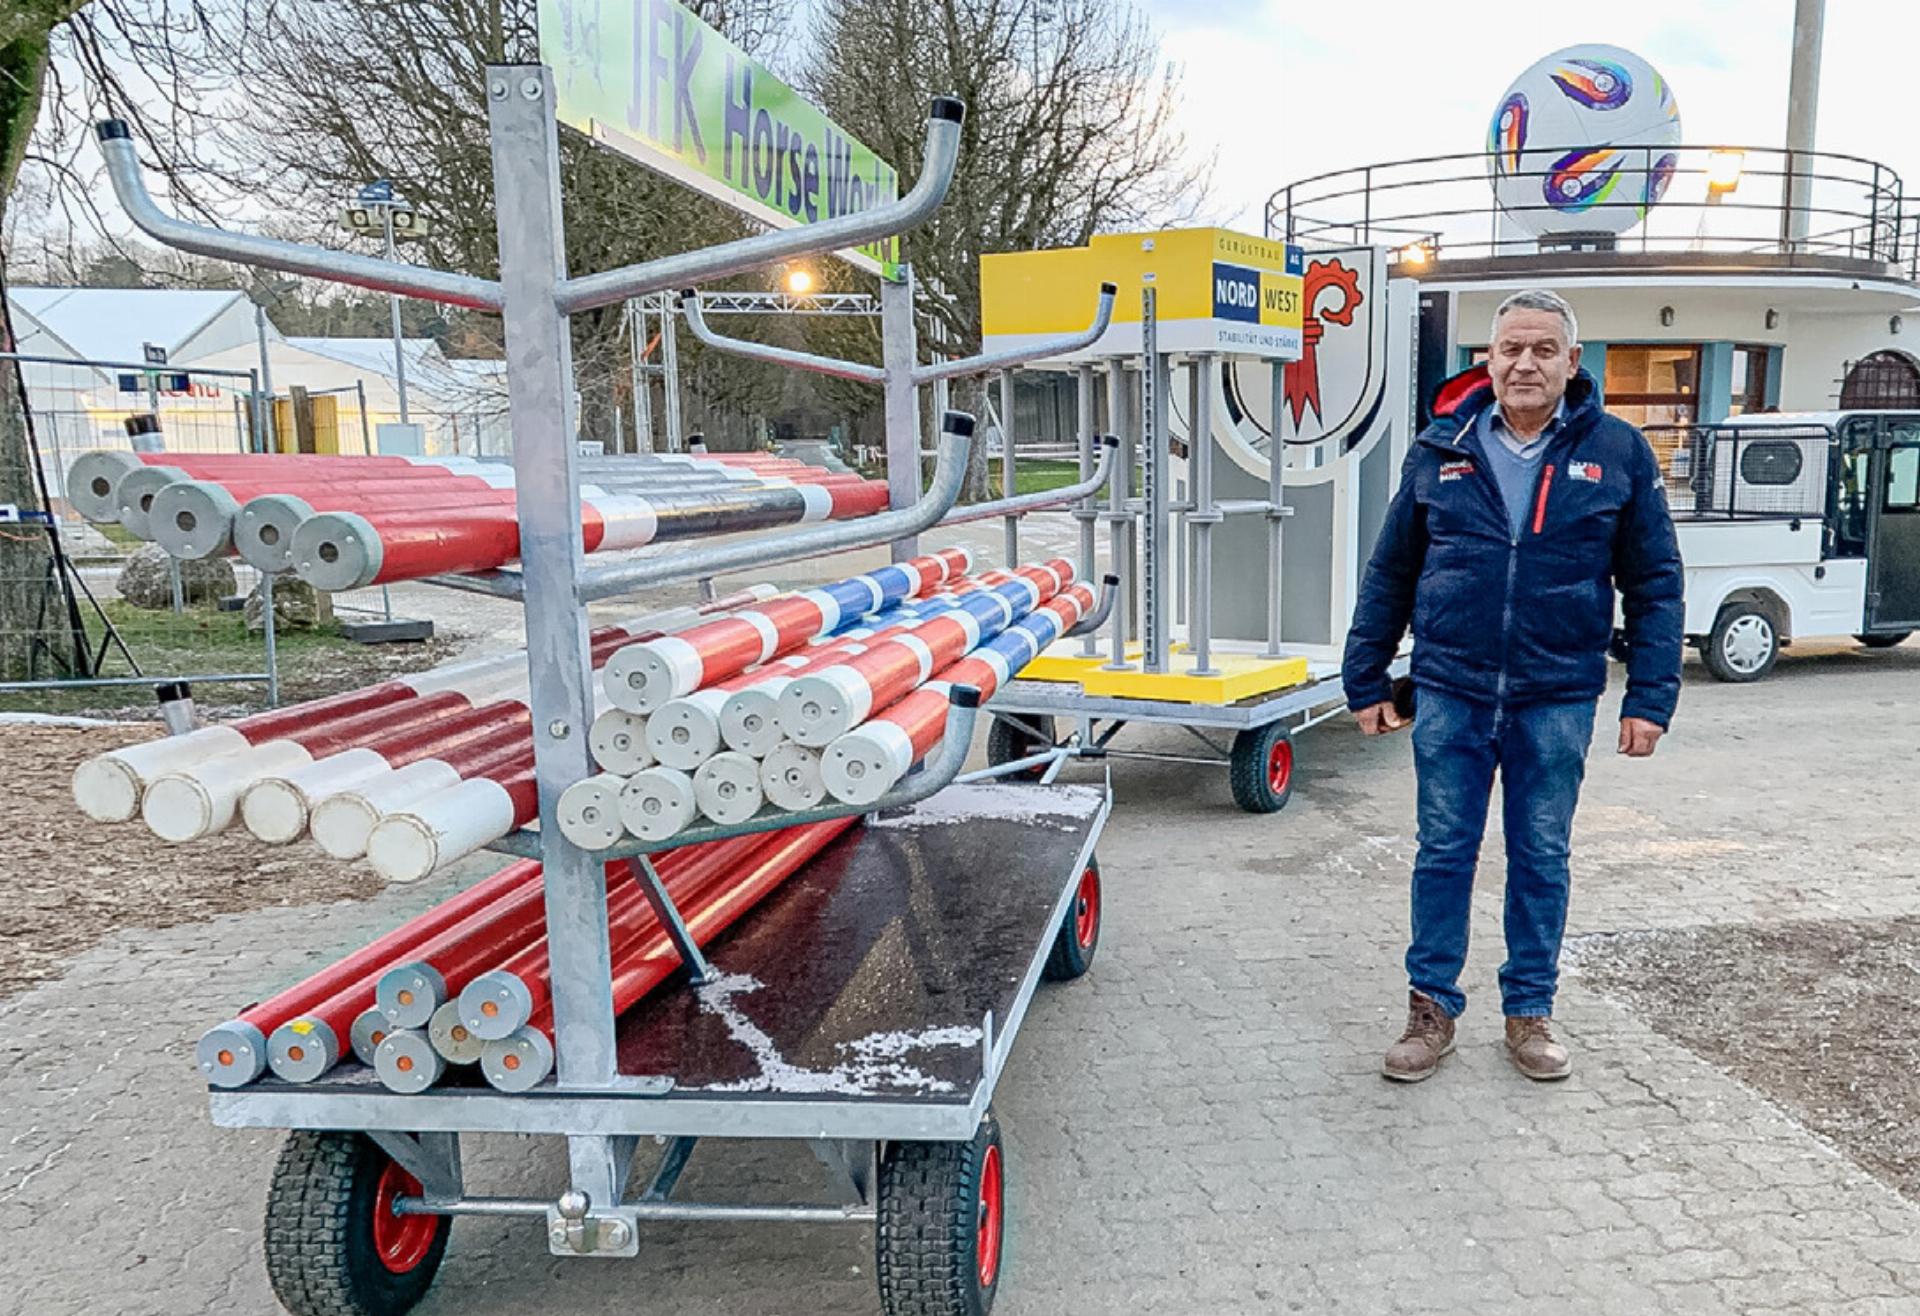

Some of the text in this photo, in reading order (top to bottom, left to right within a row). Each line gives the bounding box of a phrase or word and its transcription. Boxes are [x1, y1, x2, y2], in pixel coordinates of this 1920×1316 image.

[626, 0, 706, 165] JFK
[723, 53, 820, 224] Horse
[1219, 238, 1280, 261] GERÜSTBAU
[1216, 279, 1299, 313] NORD WEST
